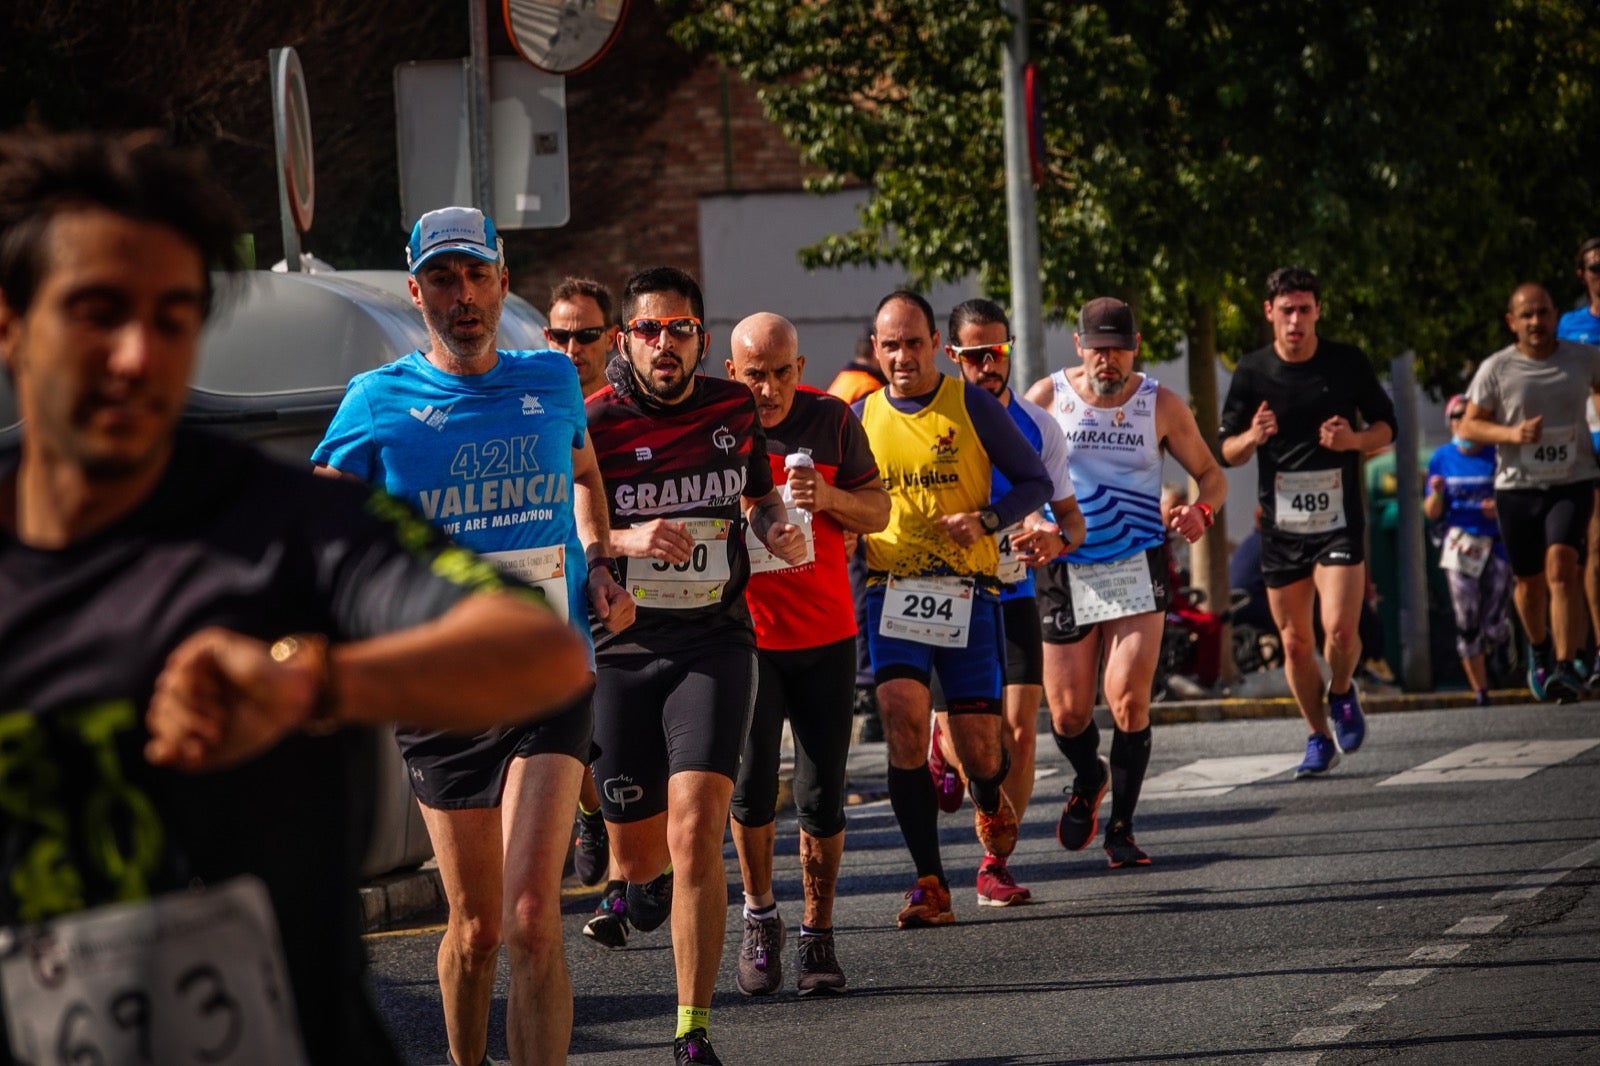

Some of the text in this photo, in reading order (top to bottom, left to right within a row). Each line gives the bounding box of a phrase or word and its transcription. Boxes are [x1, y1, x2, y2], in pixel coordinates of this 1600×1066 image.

[1066, 431, 1144, 446] MARACENA
[450, 434, 539, 480] 42K
[1534, 445, 1568, 462] 495
[903, 471, 959, 488] Vigilsa
[419, 473, 569, 520] VALENCIA
[1291, 492, 1330, 513] 489
[443, 509, 553, 535] WE ARE MARATHON
[902, 594, 954, 621] 294
